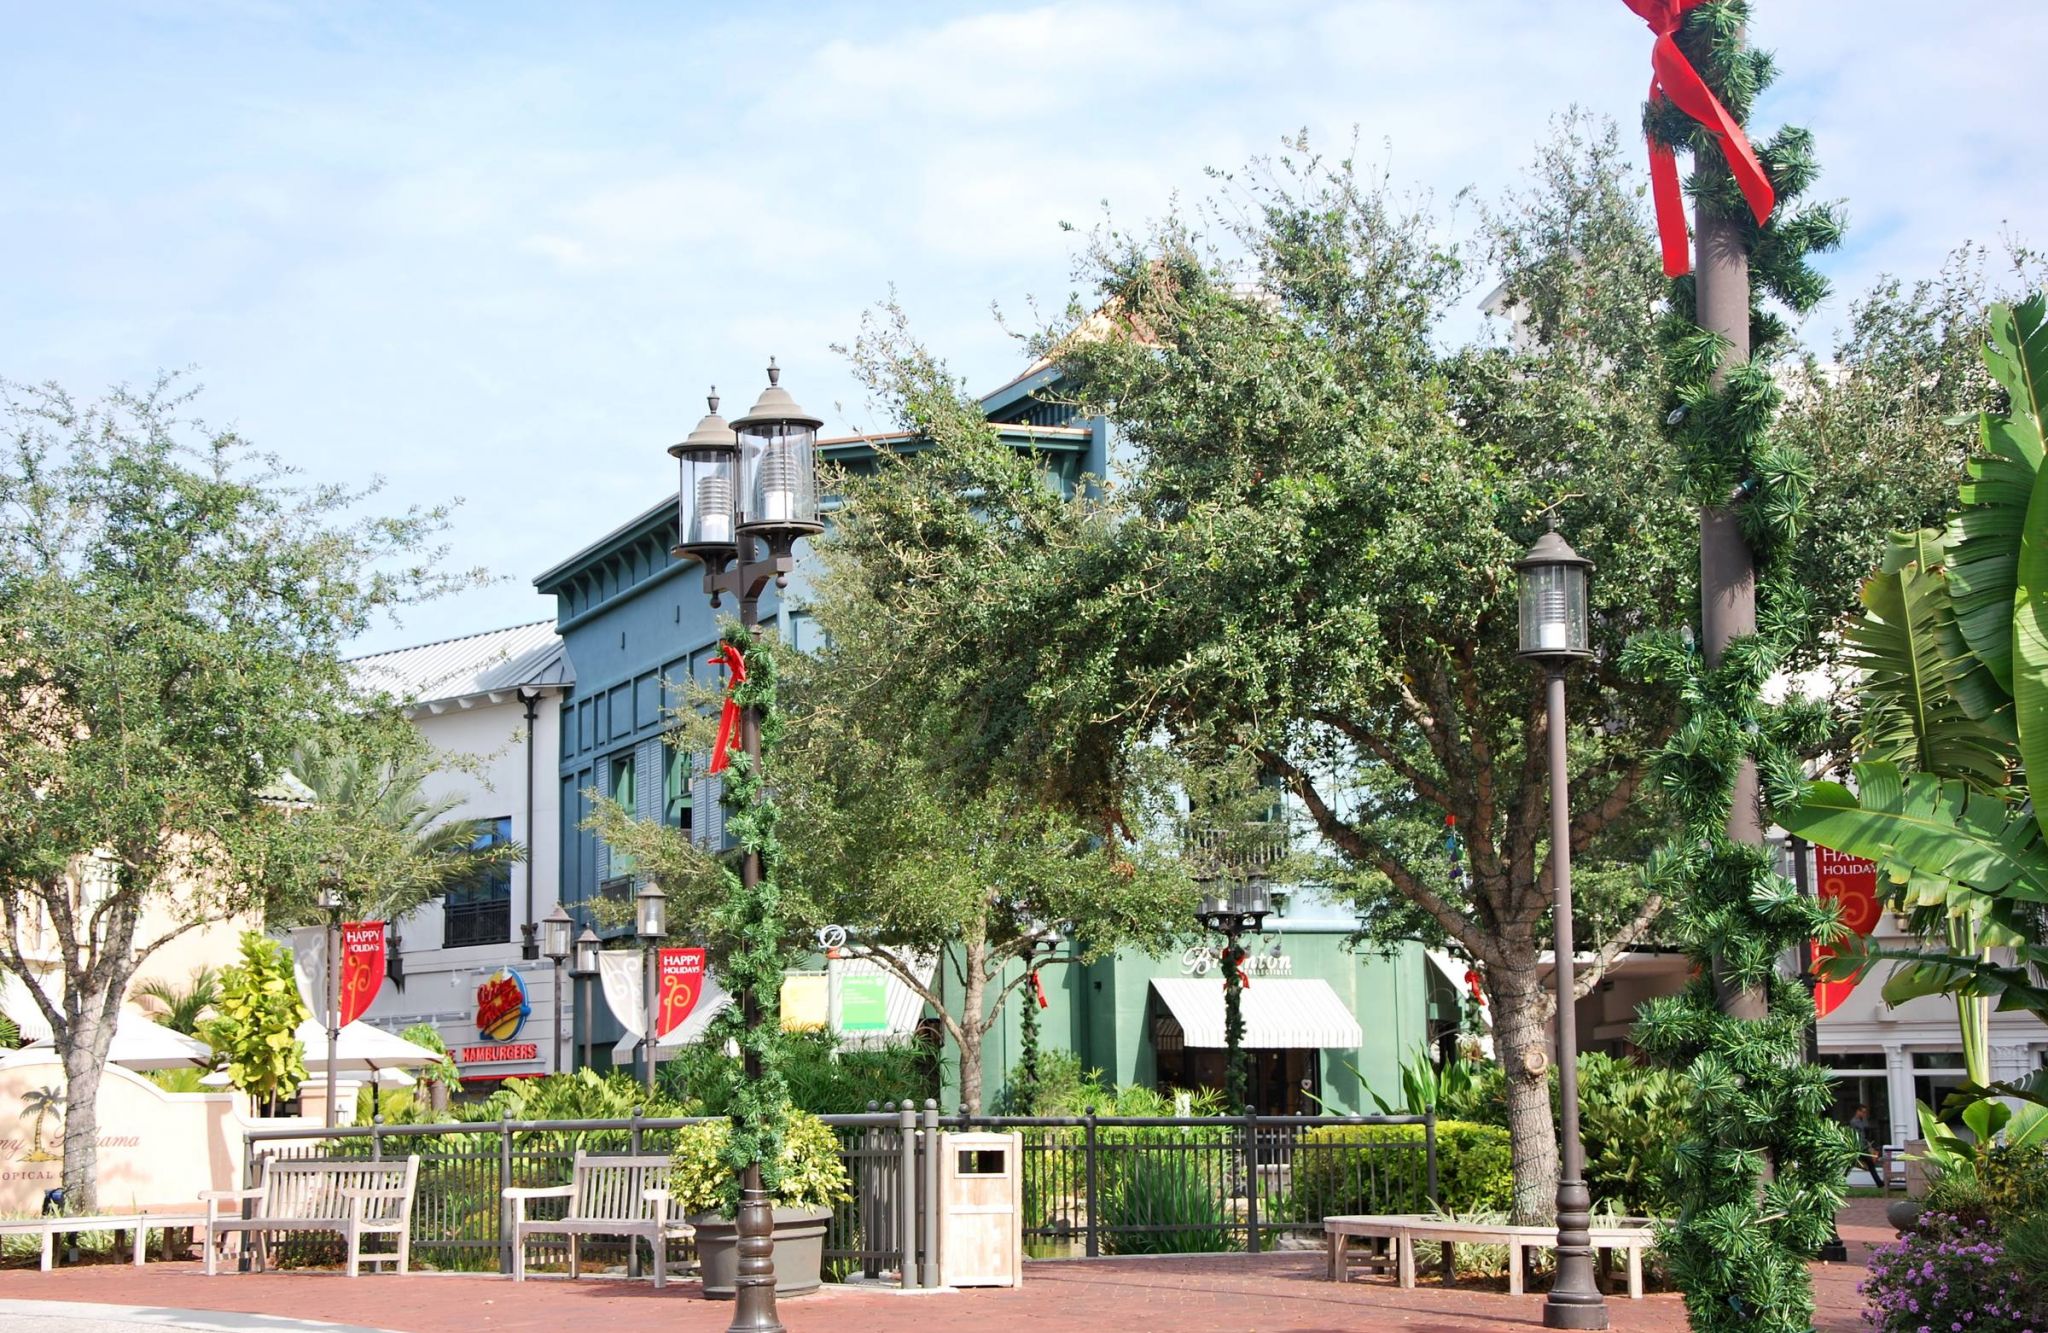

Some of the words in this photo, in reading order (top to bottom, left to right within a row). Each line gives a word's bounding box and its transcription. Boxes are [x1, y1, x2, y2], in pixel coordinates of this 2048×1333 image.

[1823, 864, 1876, 875] HOLIDAY
[346, 930, 380, 943] HAPPY
[663, 955, 700, 966] HAPPY
[663, 966, 700, 974] HOLIDAYS
[461, 1043, 537, 1063] HAMBURGERS
[1, 1171, 53, 1181] OPICAL
